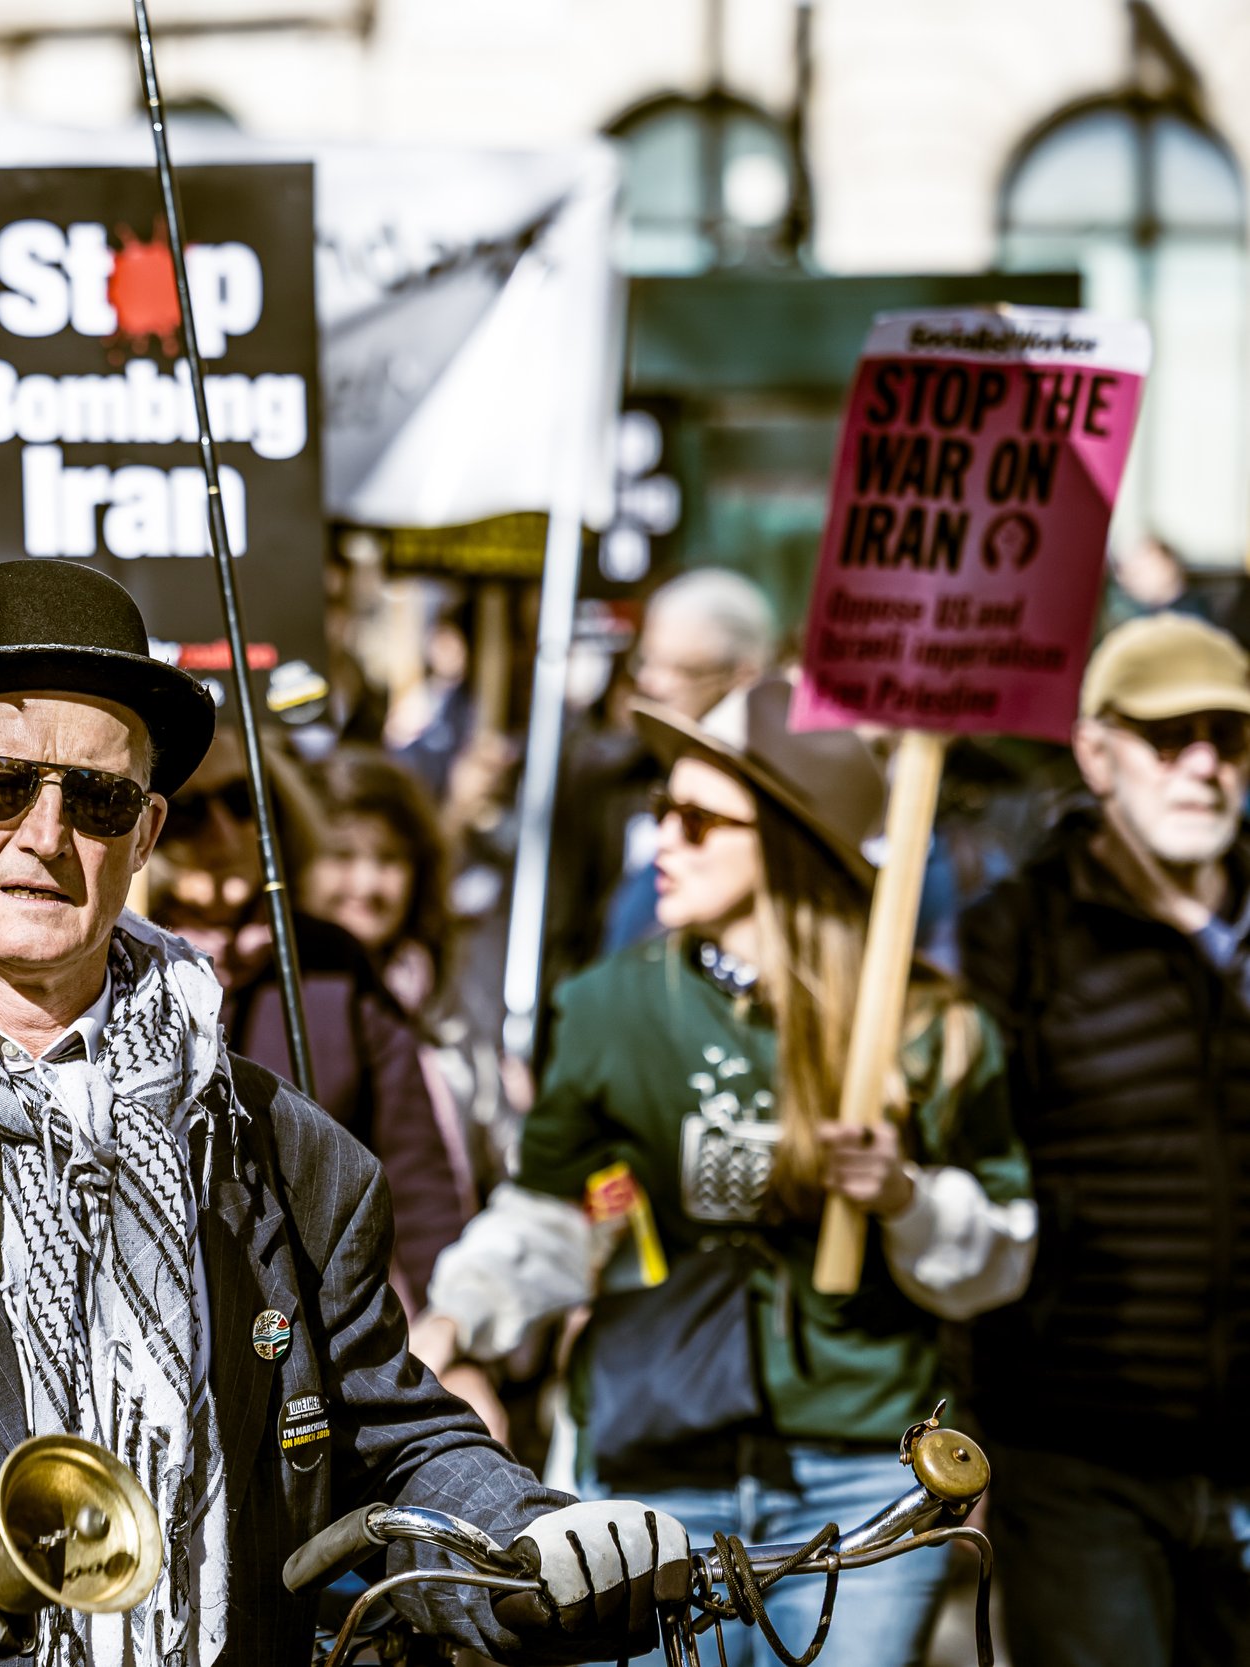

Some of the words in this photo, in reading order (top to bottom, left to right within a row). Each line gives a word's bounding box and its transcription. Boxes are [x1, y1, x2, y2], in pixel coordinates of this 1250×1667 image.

[867, 359, 1008, 435] STOP
[1024, 368, 1121, 440] THE
[22, 444, 247, 559] Iran
[856, 432, 974, 502] WAR
[986, 438, 1062, 507] ON
[840, 503, 970, 575] IRAN
[282, 1439, 293, 1449] ON
[294, 1432, 316, 1446] MARCH
[316, 1428, 330, 1440] 28th
[283, 1428, 295, 1439] I'M
[295, 1419, 328, 1436] MARCHING
[286, 1396, 321, 1415] TOGETHER
